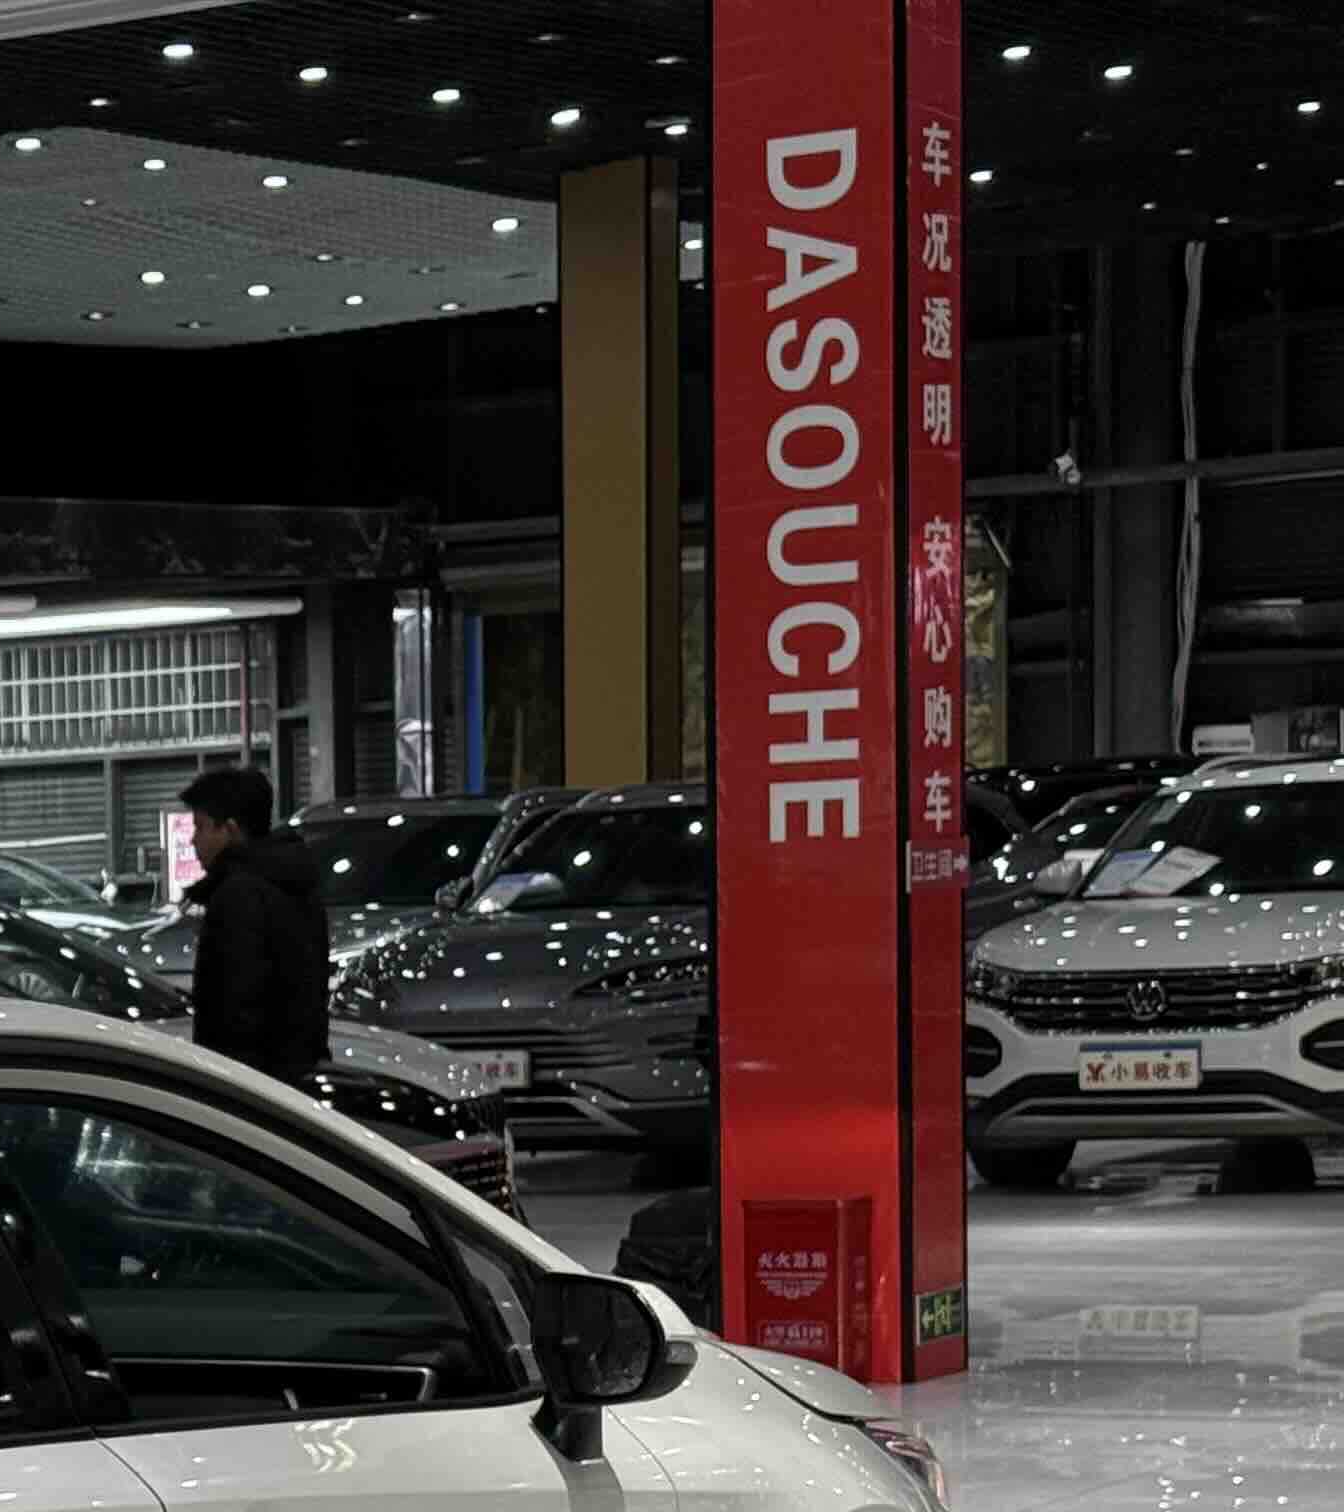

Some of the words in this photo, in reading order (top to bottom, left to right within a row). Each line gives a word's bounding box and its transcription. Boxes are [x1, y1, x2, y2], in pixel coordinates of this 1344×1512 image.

[921, 122, 953, 446] 车况透明
[766, 128, 861, 843] DASOUCHE
[921, 516, 955, 832] 安心购车
[1111, 1060, 1192, 1081] 小易收车
